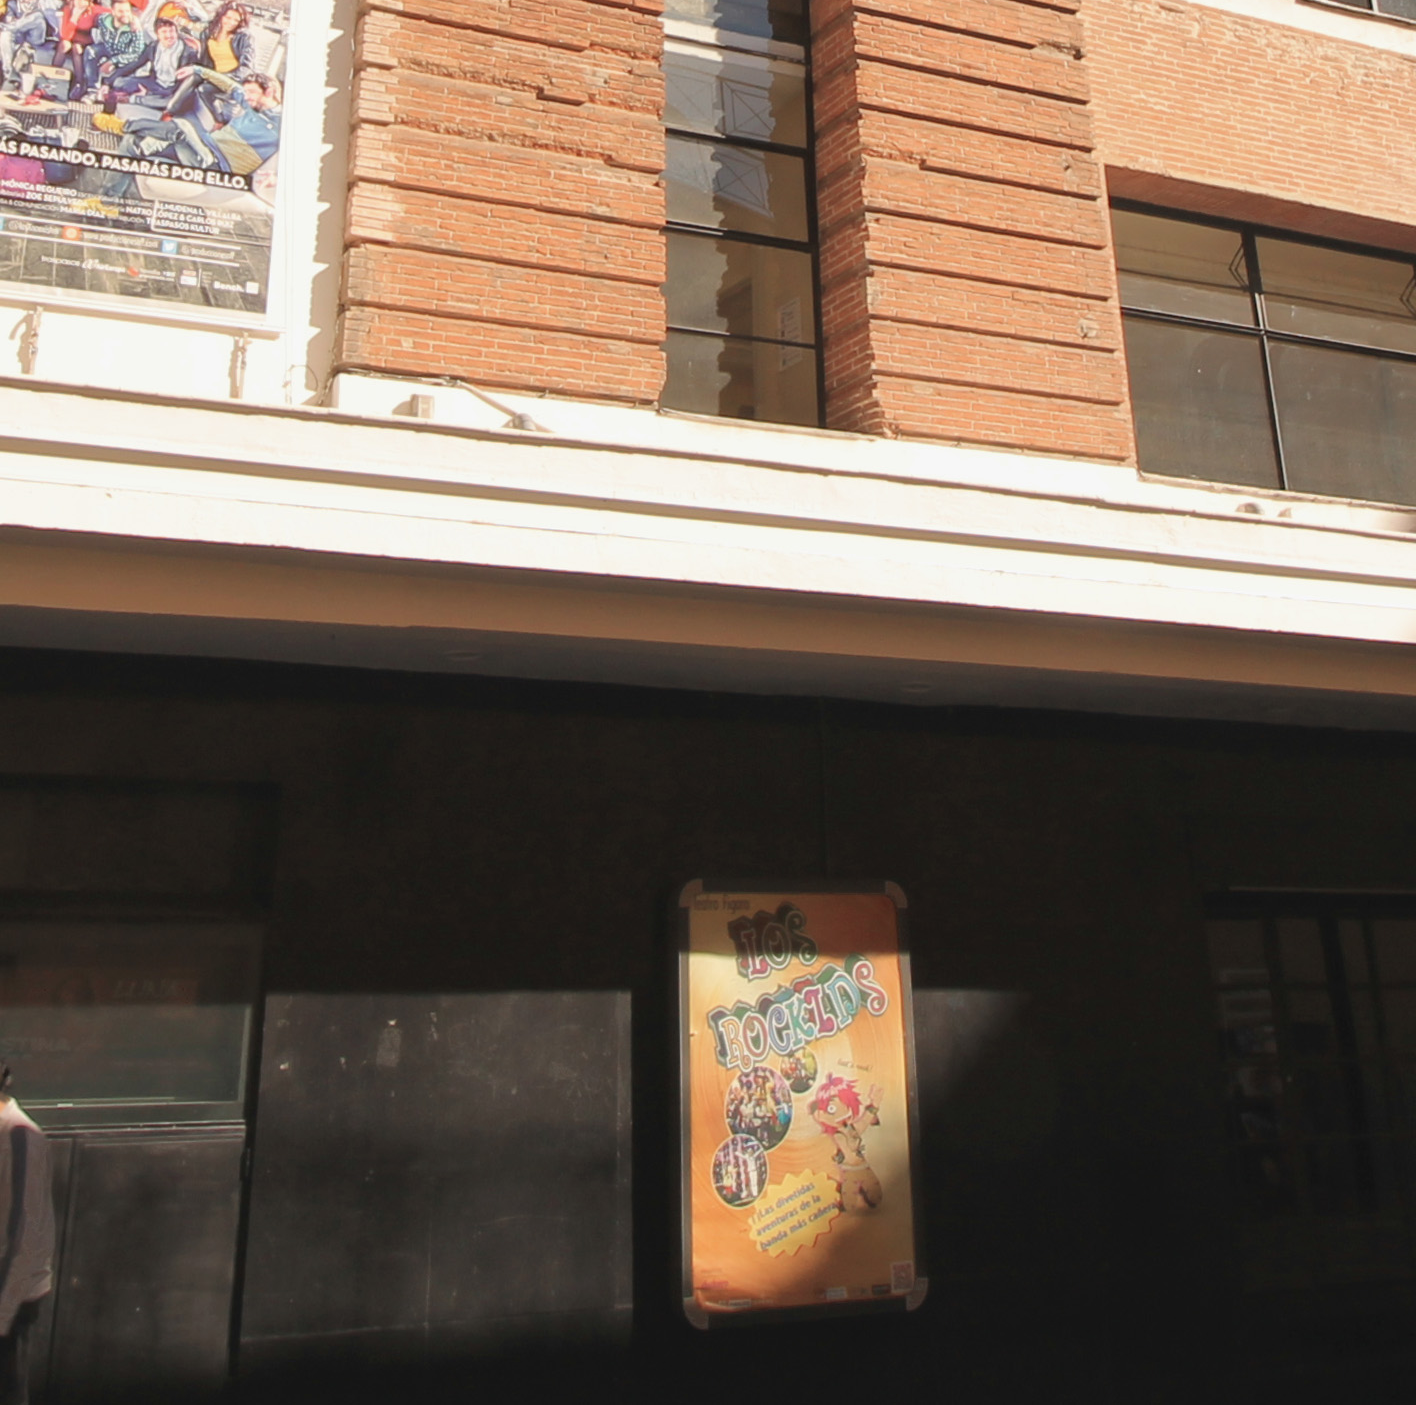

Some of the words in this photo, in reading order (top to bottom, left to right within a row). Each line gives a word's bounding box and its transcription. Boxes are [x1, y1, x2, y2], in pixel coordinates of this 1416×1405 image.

[101, 156, 169, 177] PASARÁS
[171, 165, 204, 184] POR
[205, 172, 249, 191] ELLO.
[731, 904, 818, 982] LOS
[708, 956, 888, 1074] ROCKIDS
[800, 1199, 812, 1211] de
